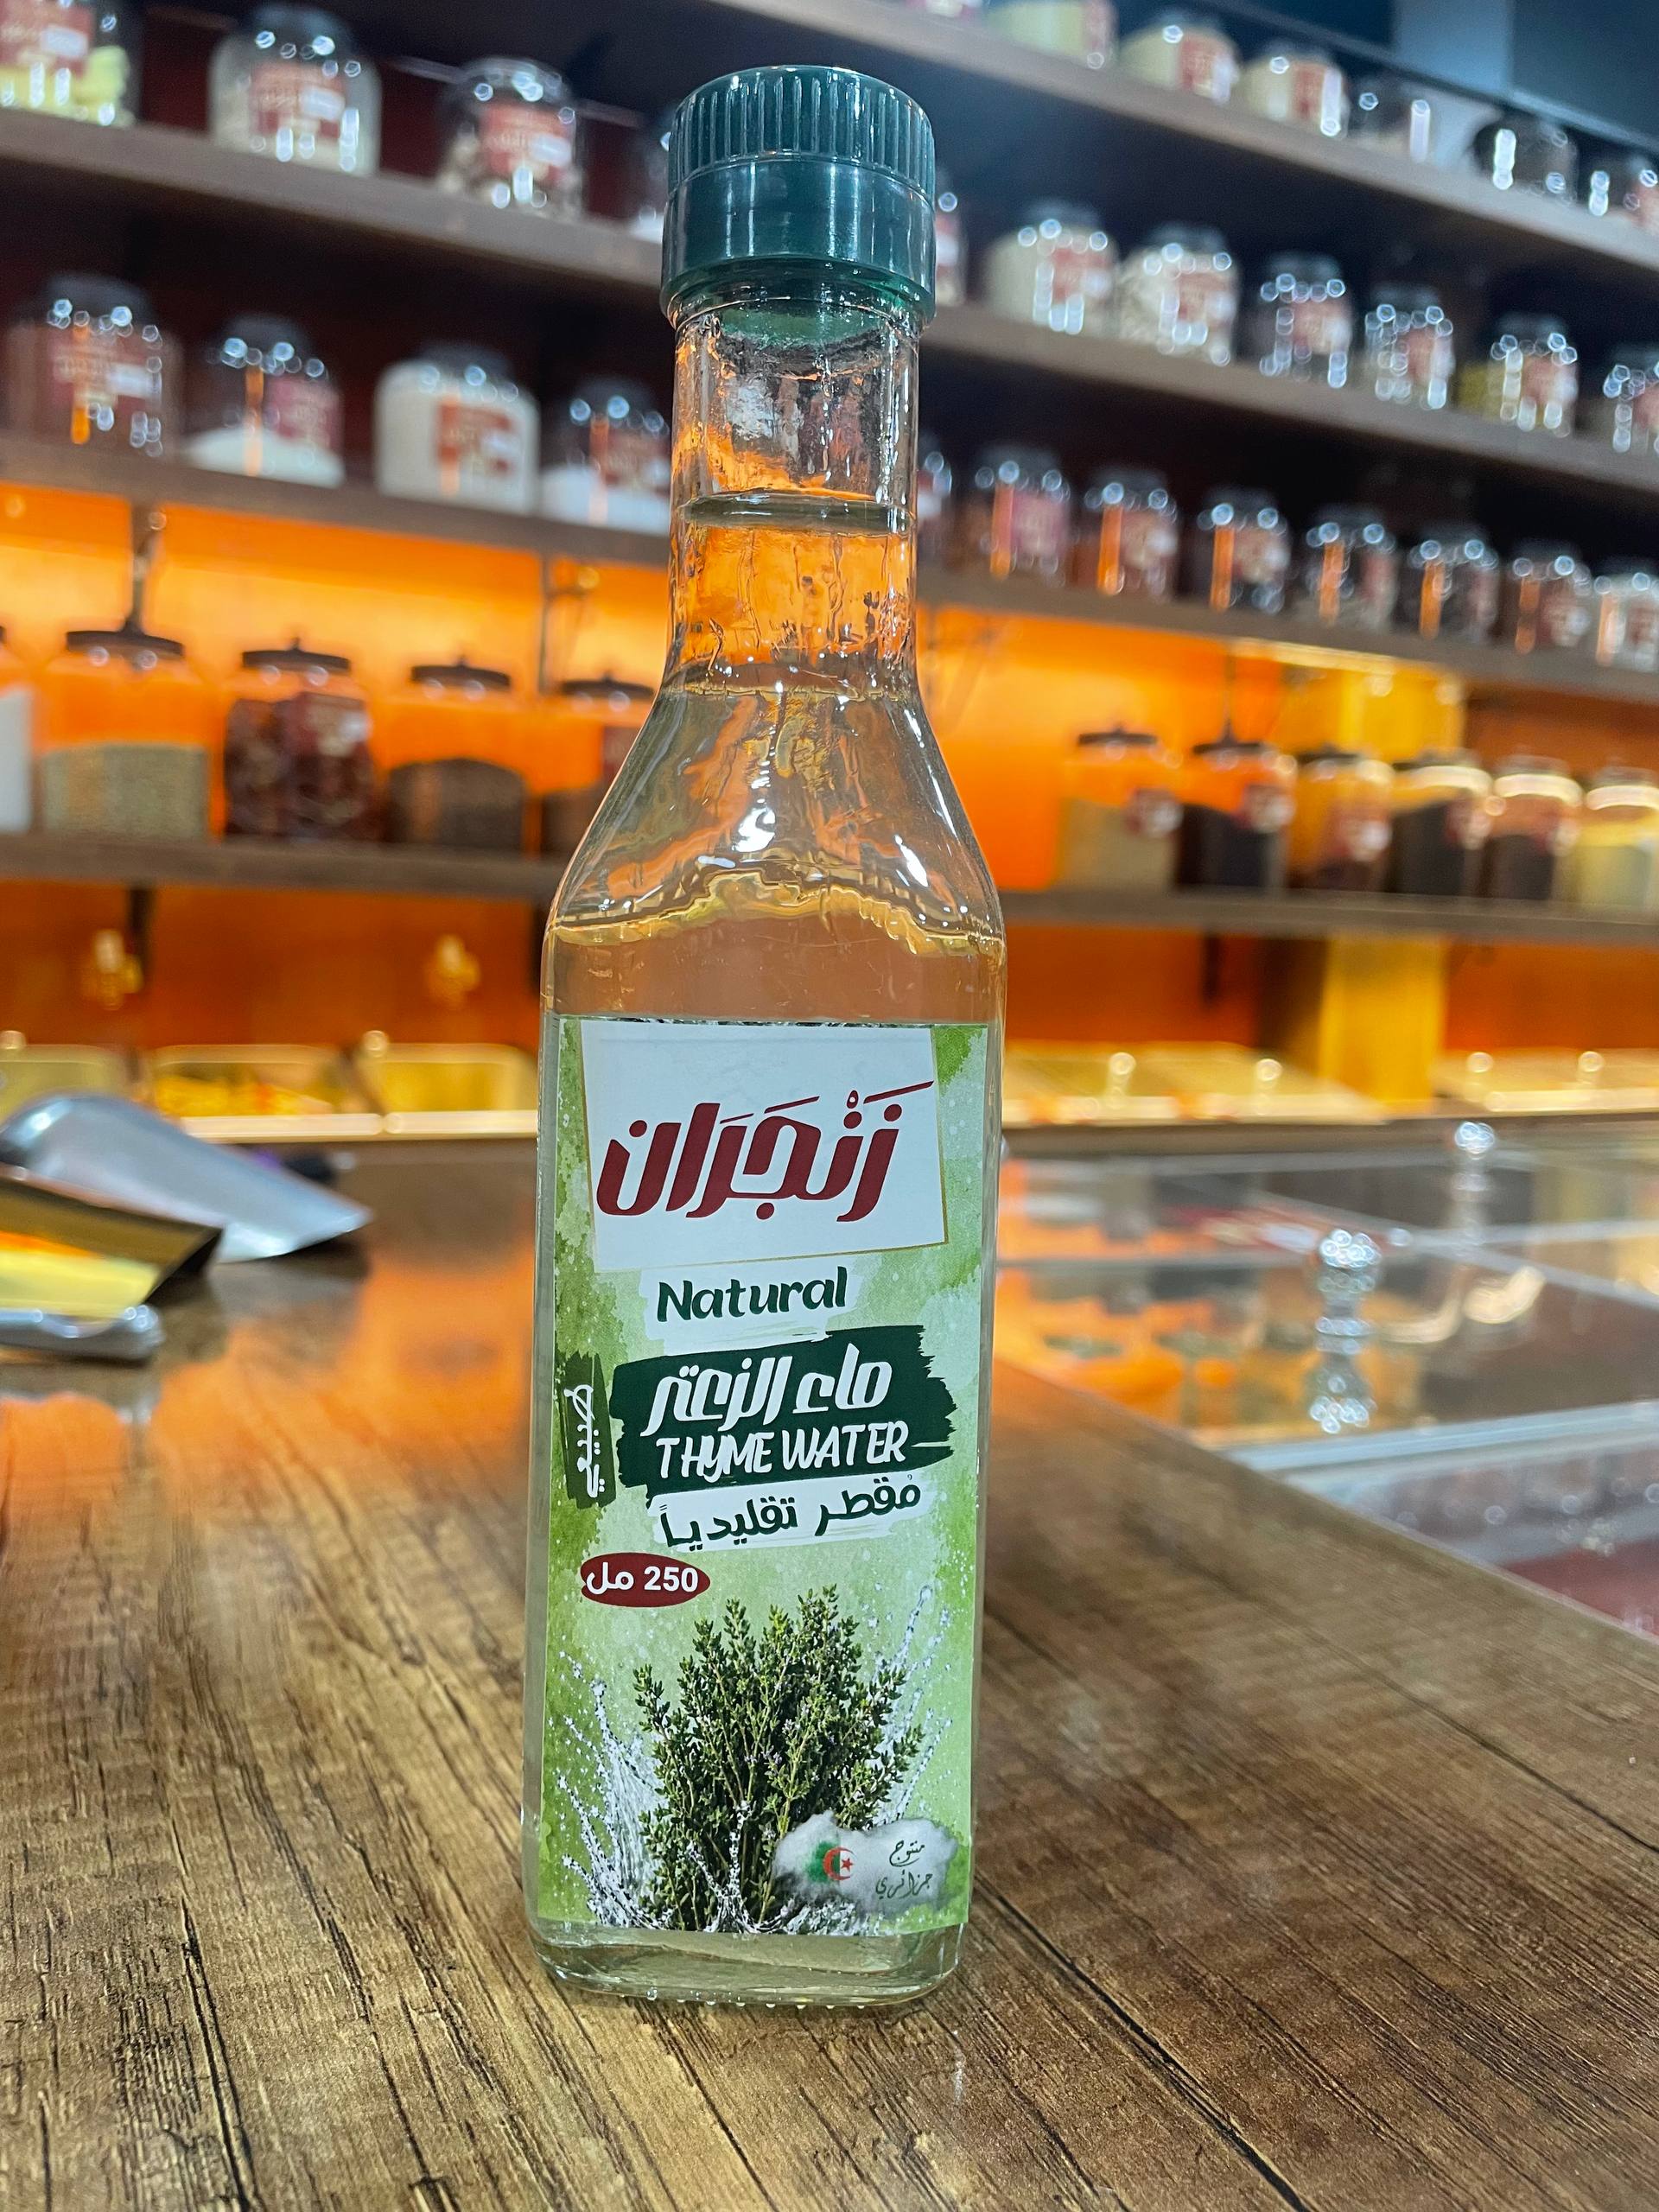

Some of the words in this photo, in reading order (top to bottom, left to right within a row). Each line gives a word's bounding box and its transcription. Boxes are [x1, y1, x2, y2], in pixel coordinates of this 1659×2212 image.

[657, 1267, 847, 1322] Natural
[640, 1357, 792, 1437] الزعتر
[792, 1343, 893, 1414] ماء
[563, 1384, 605, 1498] طبيعي
[655, 1430, 774, 1483] THYME
[782, 1421, 909, 1471] WATER
[586, 1562, 634, 1594] مل
[644, 1565, 699, 1593] 250
[889, 1840, 925, 1867] منتوج
[875, 1869, 933, 1899] جزائري
